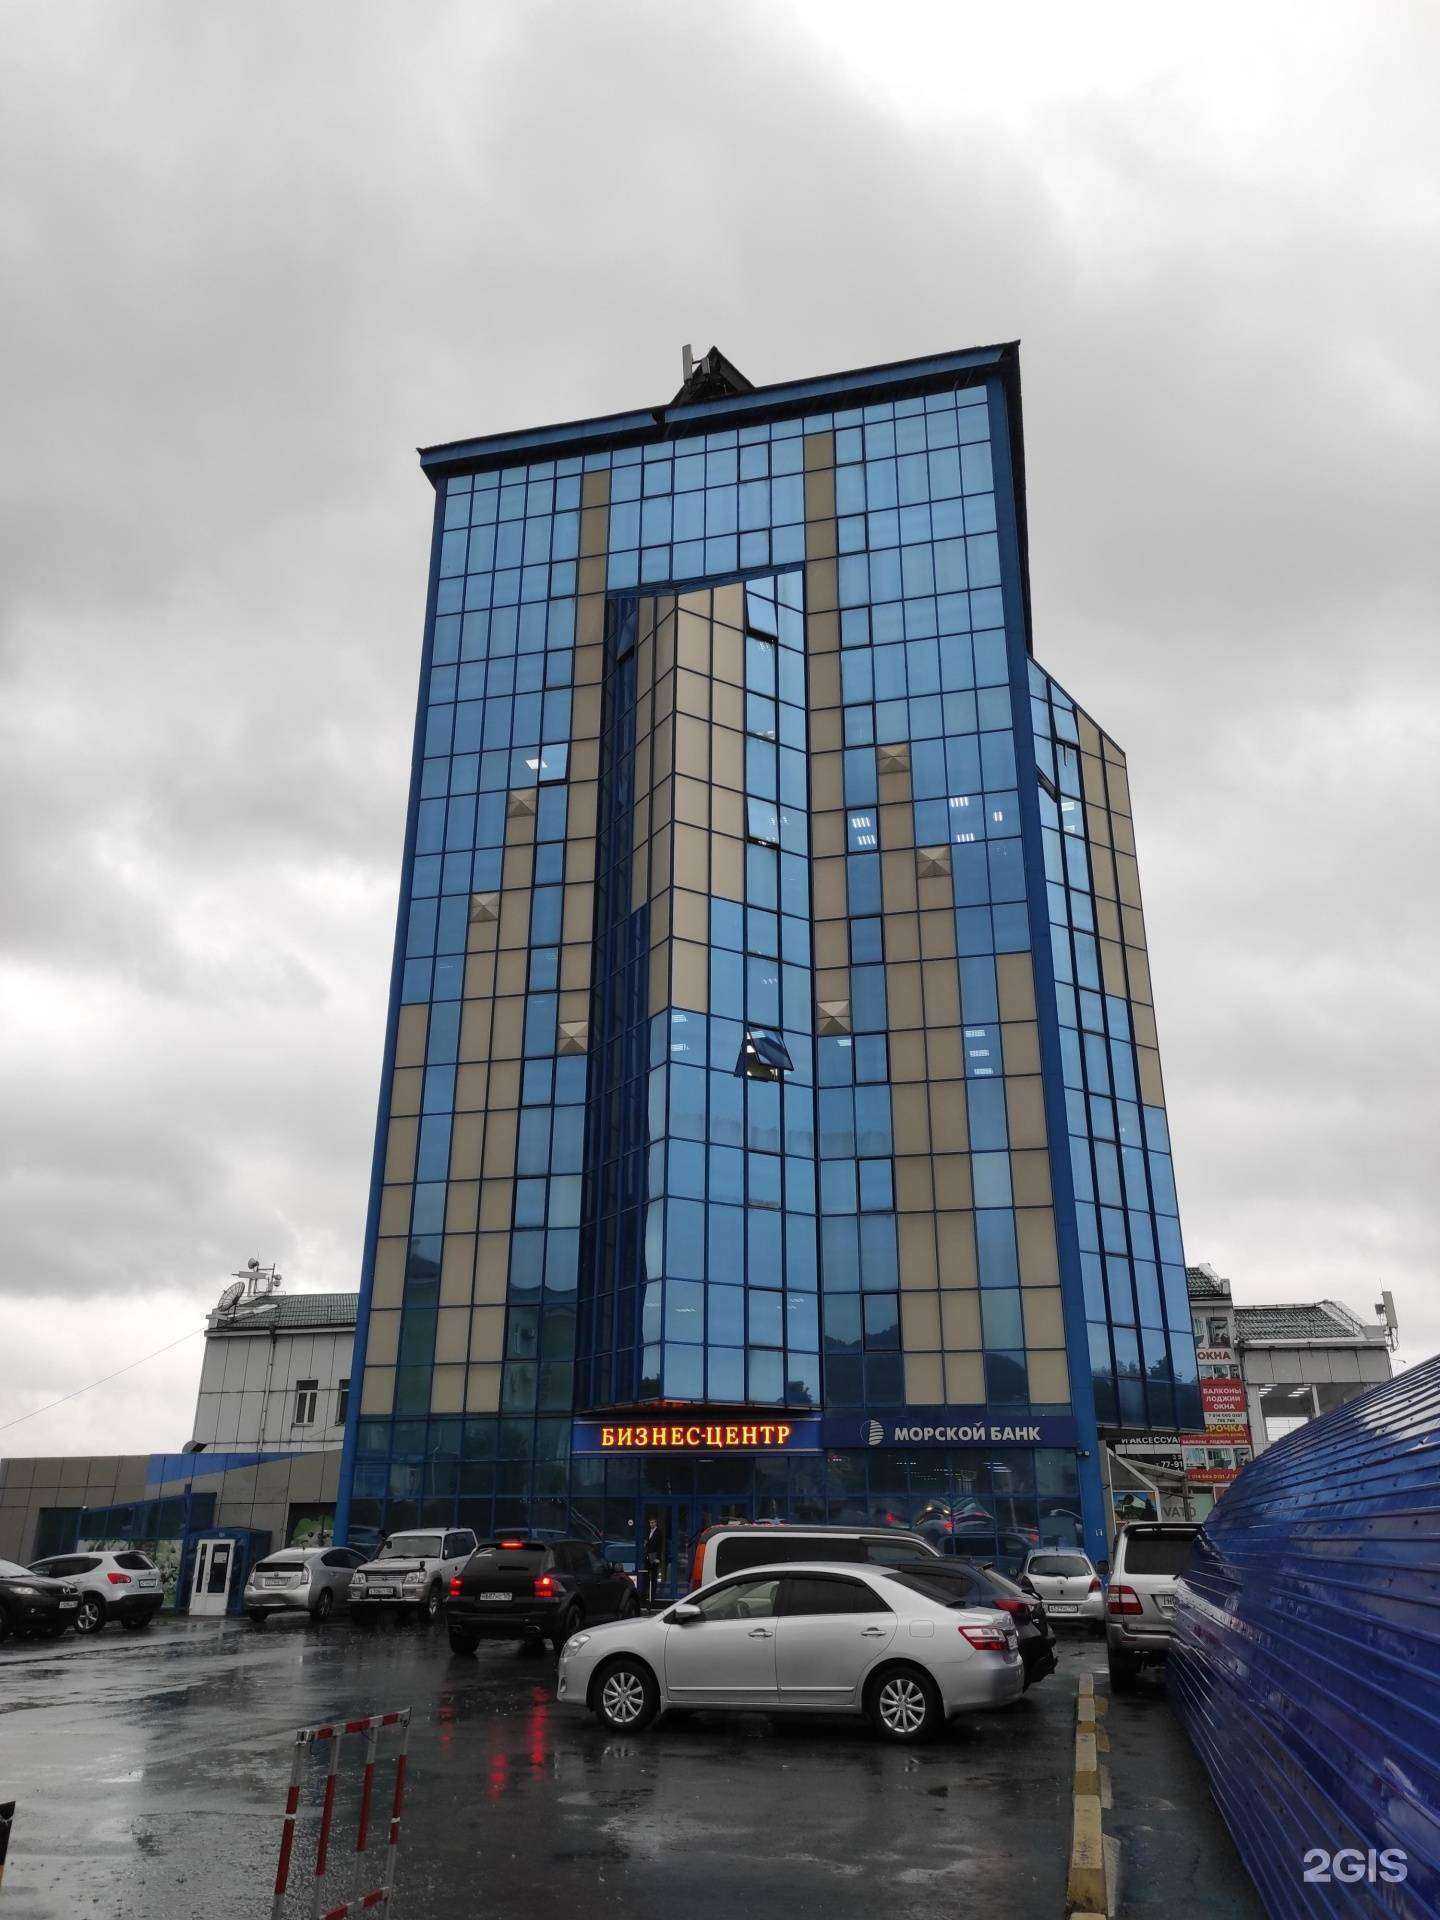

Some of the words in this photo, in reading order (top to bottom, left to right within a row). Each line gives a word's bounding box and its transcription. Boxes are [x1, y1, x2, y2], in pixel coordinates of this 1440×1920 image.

[1197, 1351, 1231, 1360] ОКНА
[1202, 1387, 1242, 1395] БАЛКОНЫ
[1205, 1395, 1241, 1403] ЛОДЖИИ
[894, 1421, 986, 1441] МОРСКОЙ
[990, 1426, 1042, 1441] БАНК
[601, 1426, 791, 1448] БИЗНЕС-ЦЕНТР
[1129, 1436, 1180, 1444] АКСЕССУА
